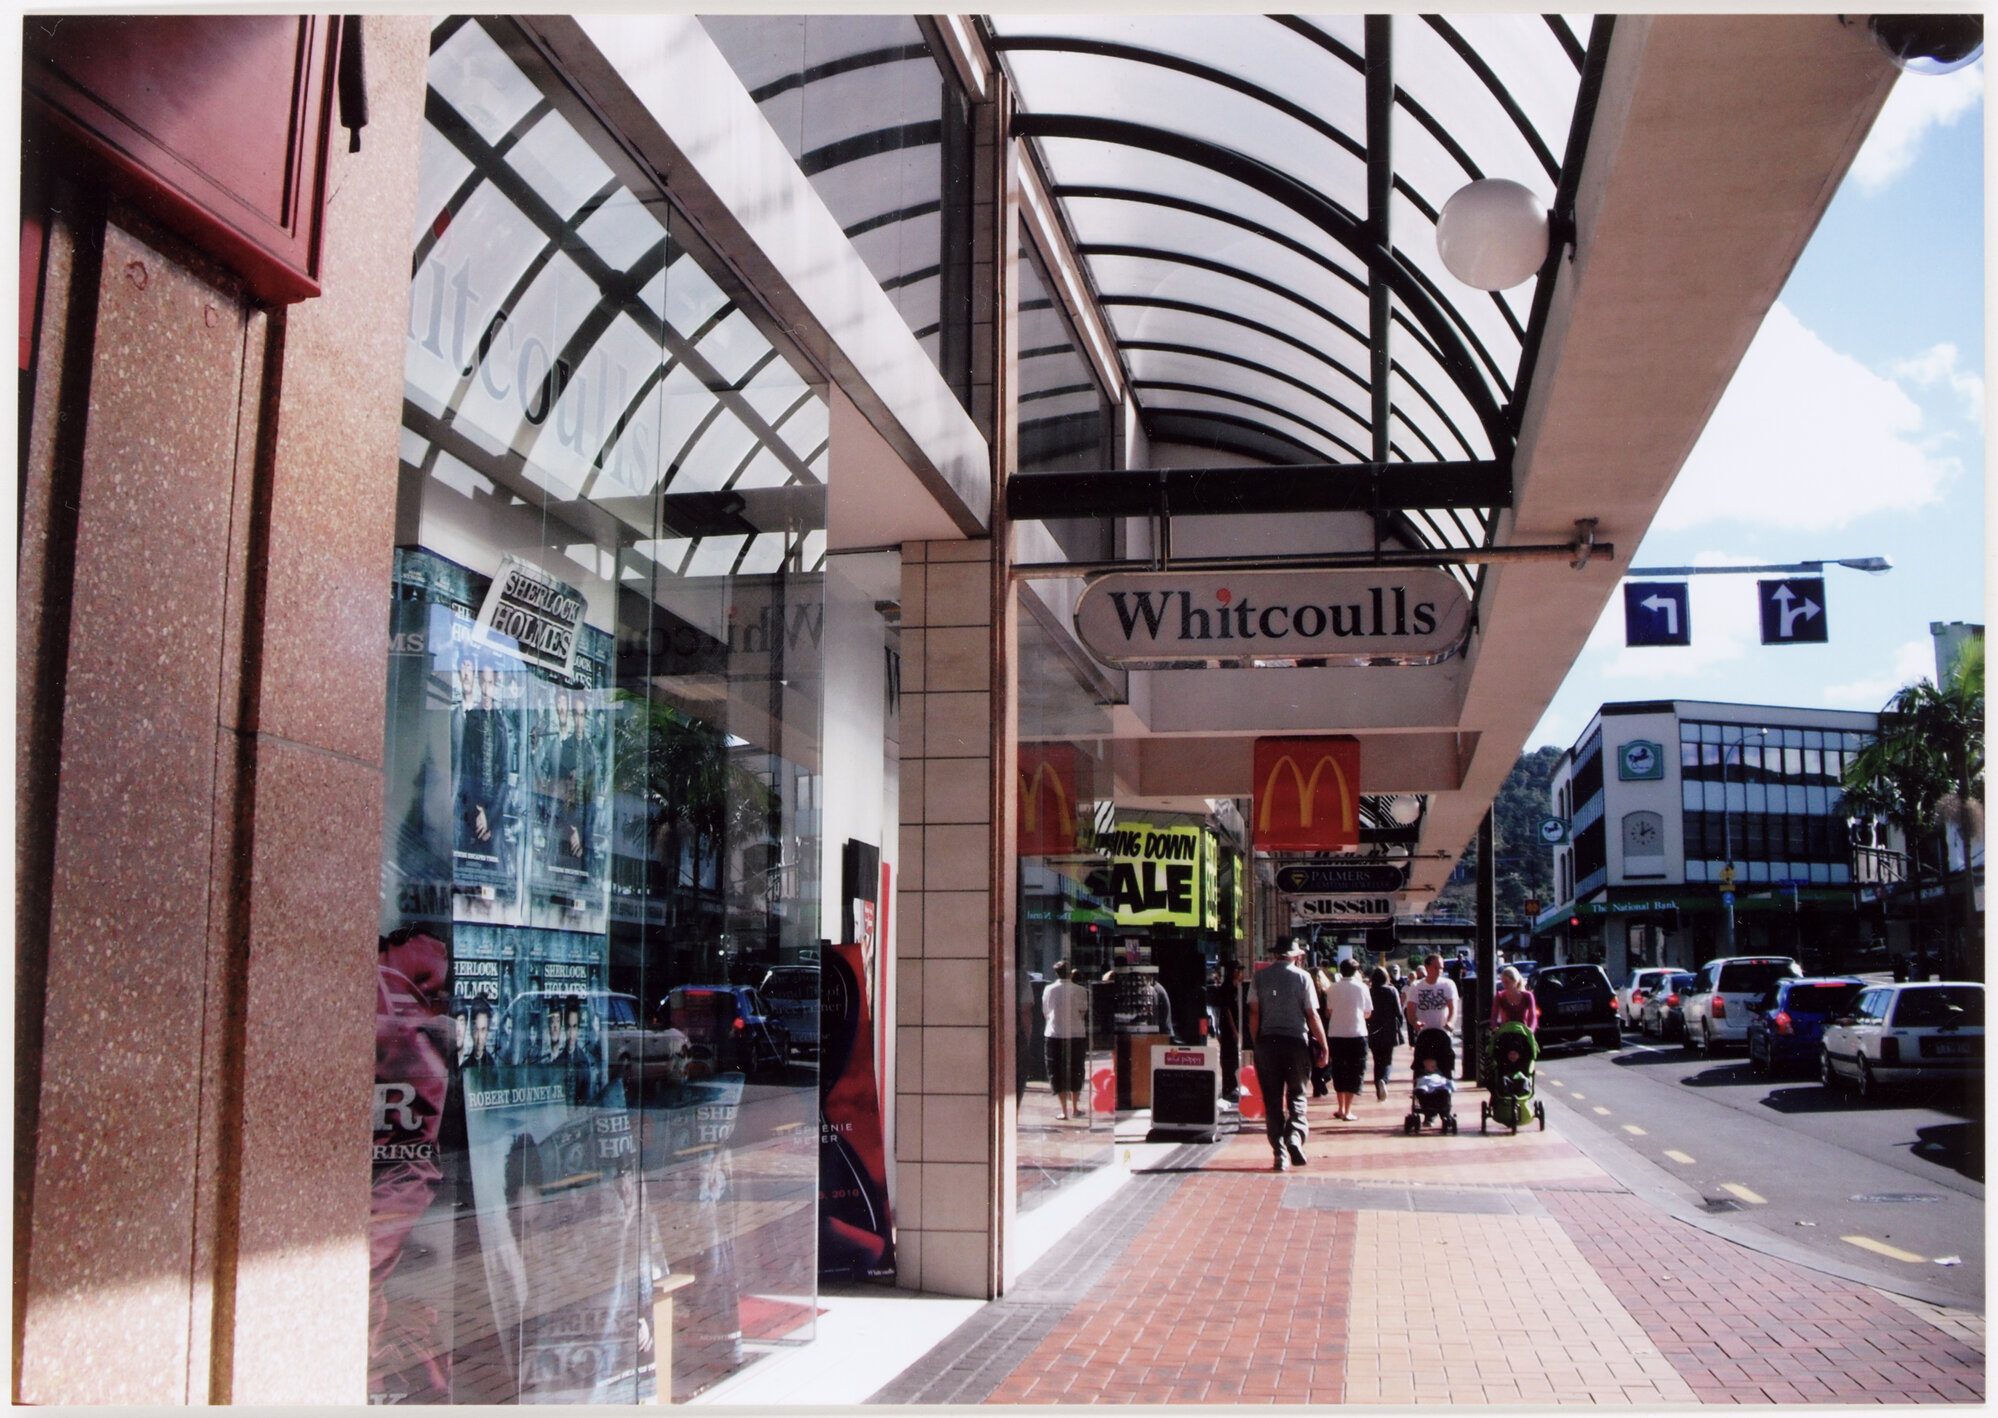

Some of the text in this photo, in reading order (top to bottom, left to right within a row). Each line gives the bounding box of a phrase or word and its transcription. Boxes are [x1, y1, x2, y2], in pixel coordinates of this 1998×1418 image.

[504, 571, 580, 623] SHERLOCK
[1108, 586, 1437, 641] Whitcoulls
[491, 604, 574, 660] HOLMES
[1144, 832, 1197, 860] DOWN
[1311, 870, 1371, 881] PALMERS
[1303, 899, 1390, 914] sussan
[1592, 900, 1678, 913] The National Bank
[544, 964, 587, 979] SHERLOCK
[469, 1090, 509, 1108] ROBERT
[512, 1086, 551, 1104] DOWNEY
